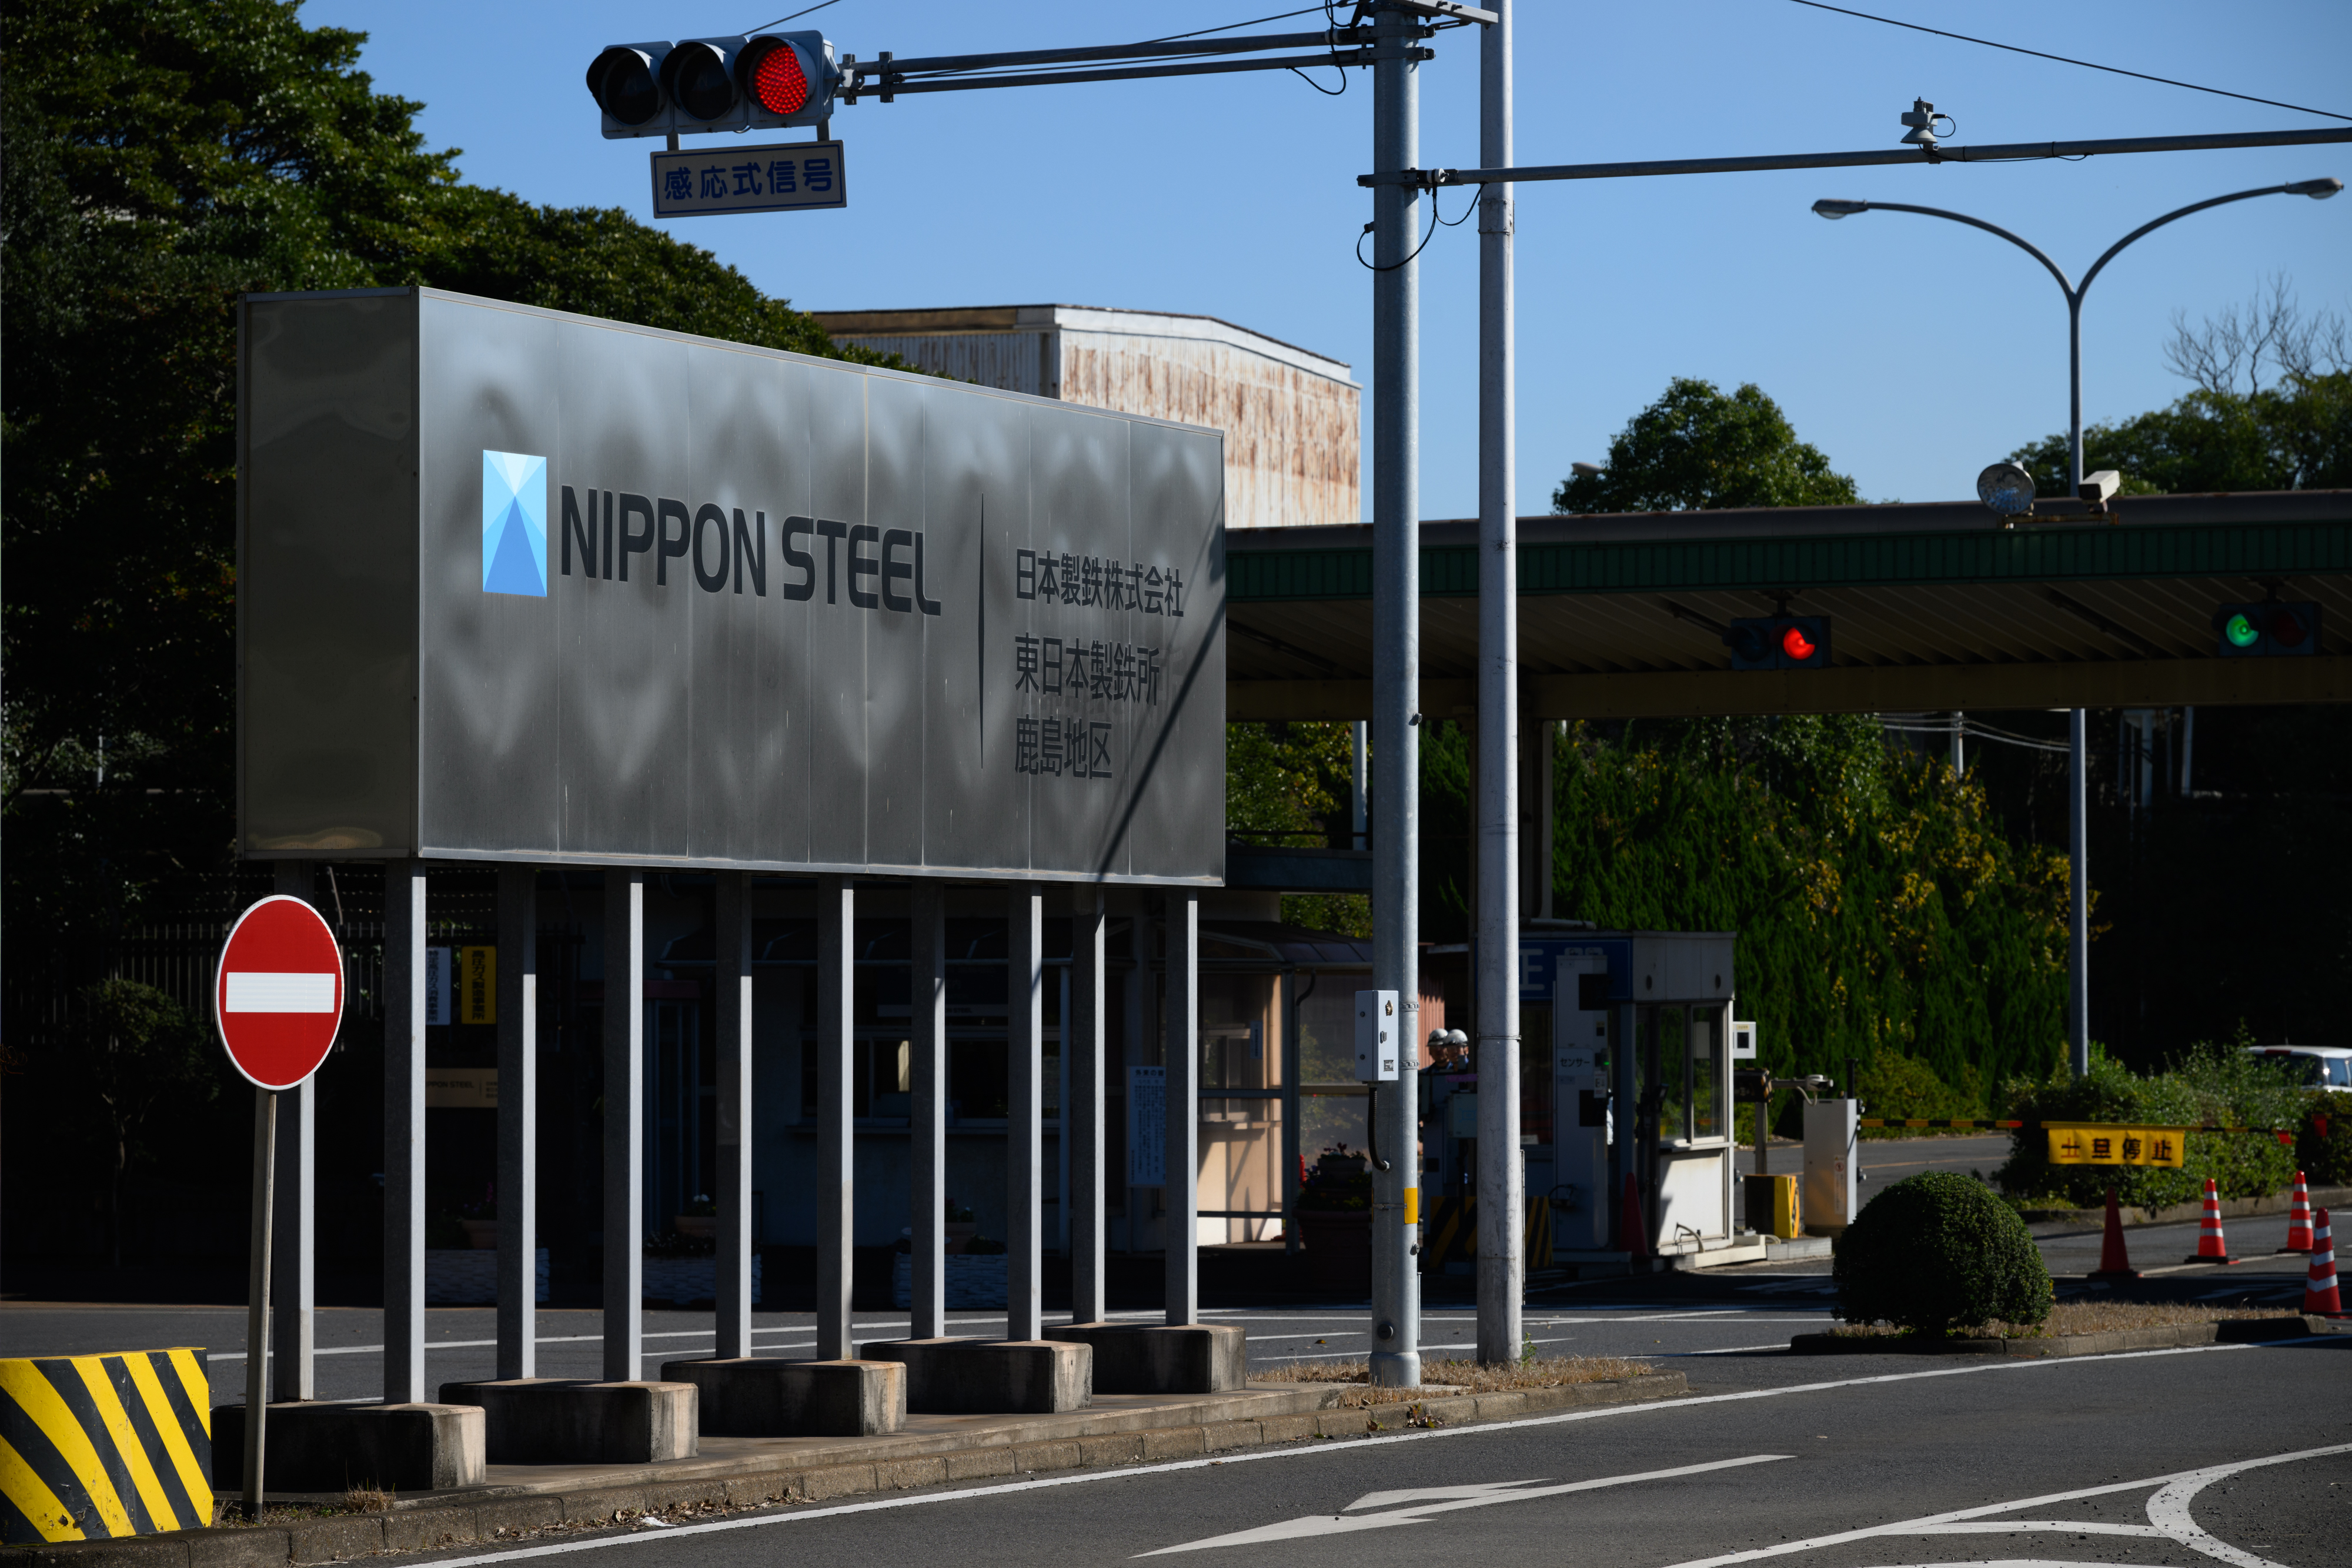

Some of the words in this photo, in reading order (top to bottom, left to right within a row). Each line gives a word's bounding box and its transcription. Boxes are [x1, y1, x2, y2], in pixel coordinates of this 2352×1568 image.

[664, 158, 833, 200] 感応式信号
[562, 485, 766, 597] NIPPON
[781, 516, 941, 617] STEEL
[1016, 549, 1184, 617] 日本製鉄株式会社
[1014, 632, 1160, 706] 東日本製鉄所
[1014, 714, 1112, 780] 鹿島地区
[472, 950, 485, 1020] 高圧ガス製造事業所
[1560, 1058, 1591, 1068] センサー
